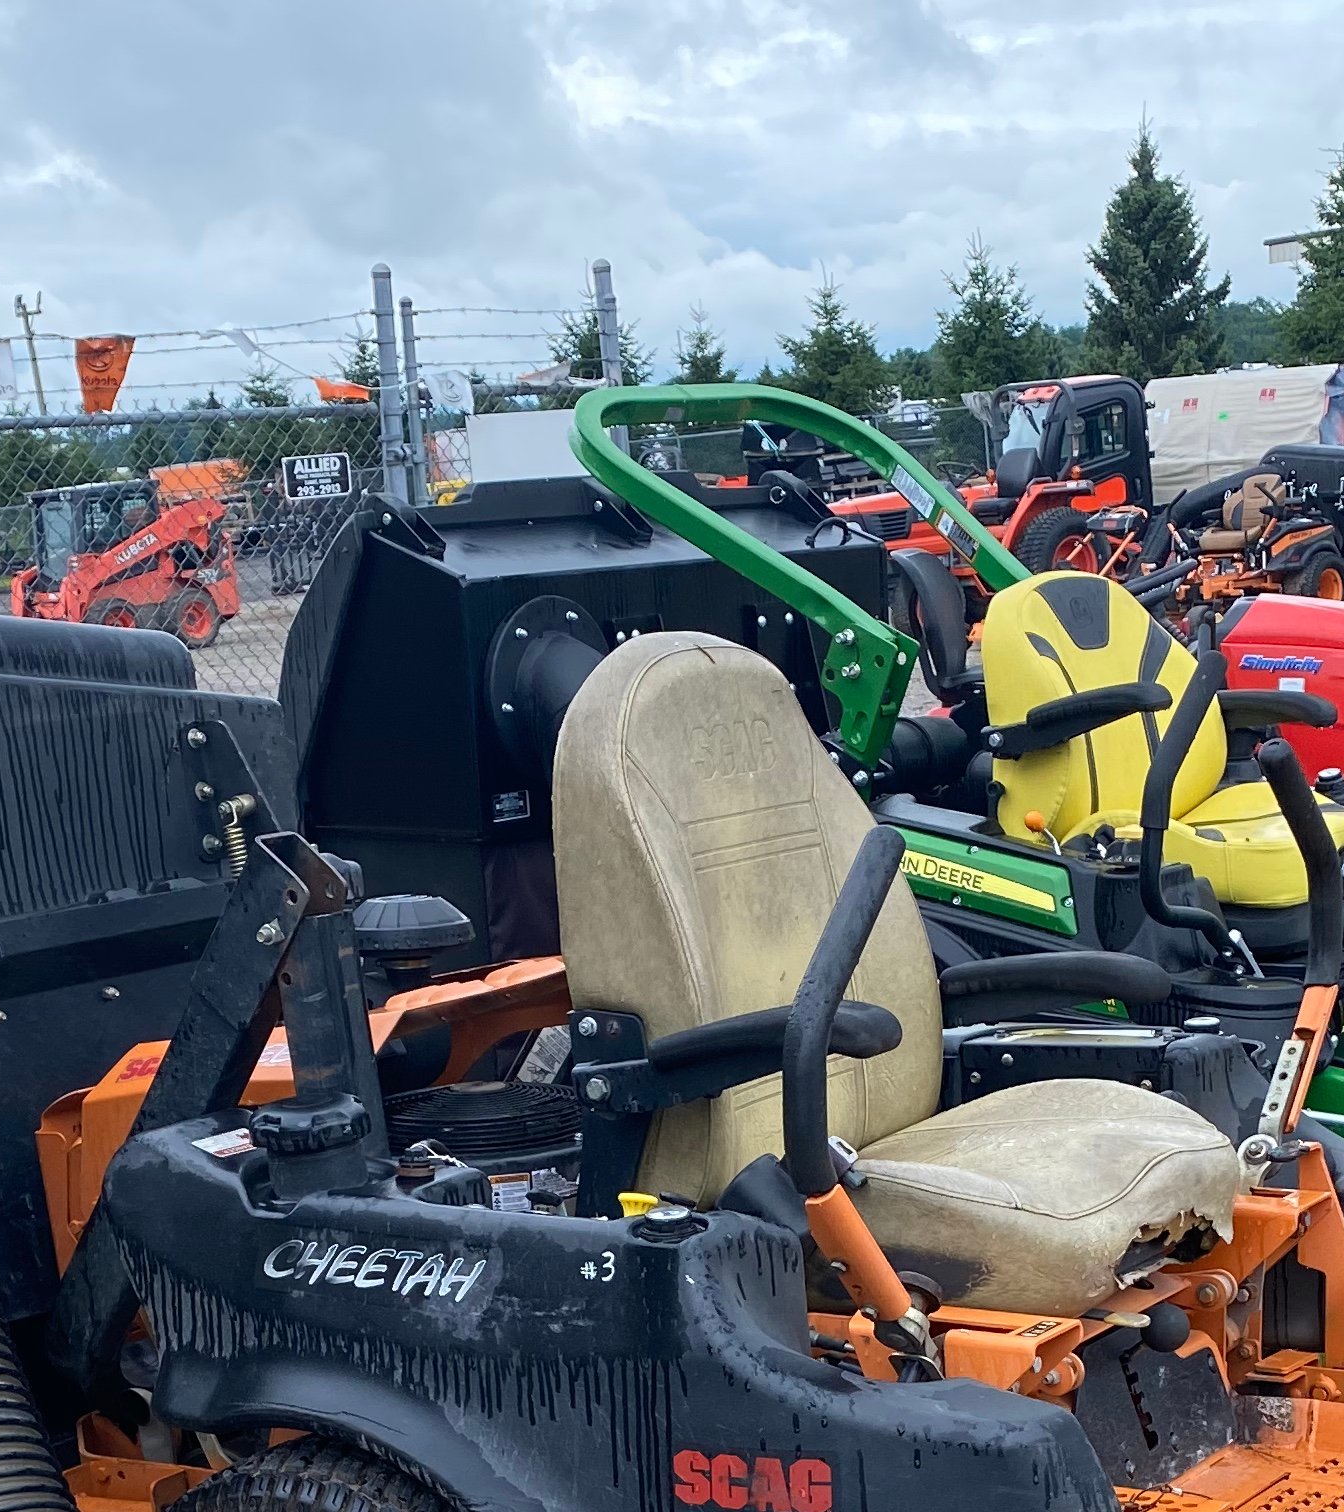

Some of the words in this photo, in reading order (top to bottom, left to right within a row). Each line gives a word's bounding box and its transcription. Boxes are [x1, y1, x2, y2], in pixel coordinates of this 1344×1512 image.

[81, 375, 118, 386] Kubota
[293, 456, 341, 474] ALLIED
[297, 483, 341, 496] 293-2913
[114, 533, 158, 564] KUBOTA
[1239, 654, 1324, 674] Simplicity
[923, 858, 985, 890] DEERE
[117, 1056, 161, 1081] SC
[263, 1239, 487, 1302] CHEETAH
[580, 1251, 616, 1282] #3
